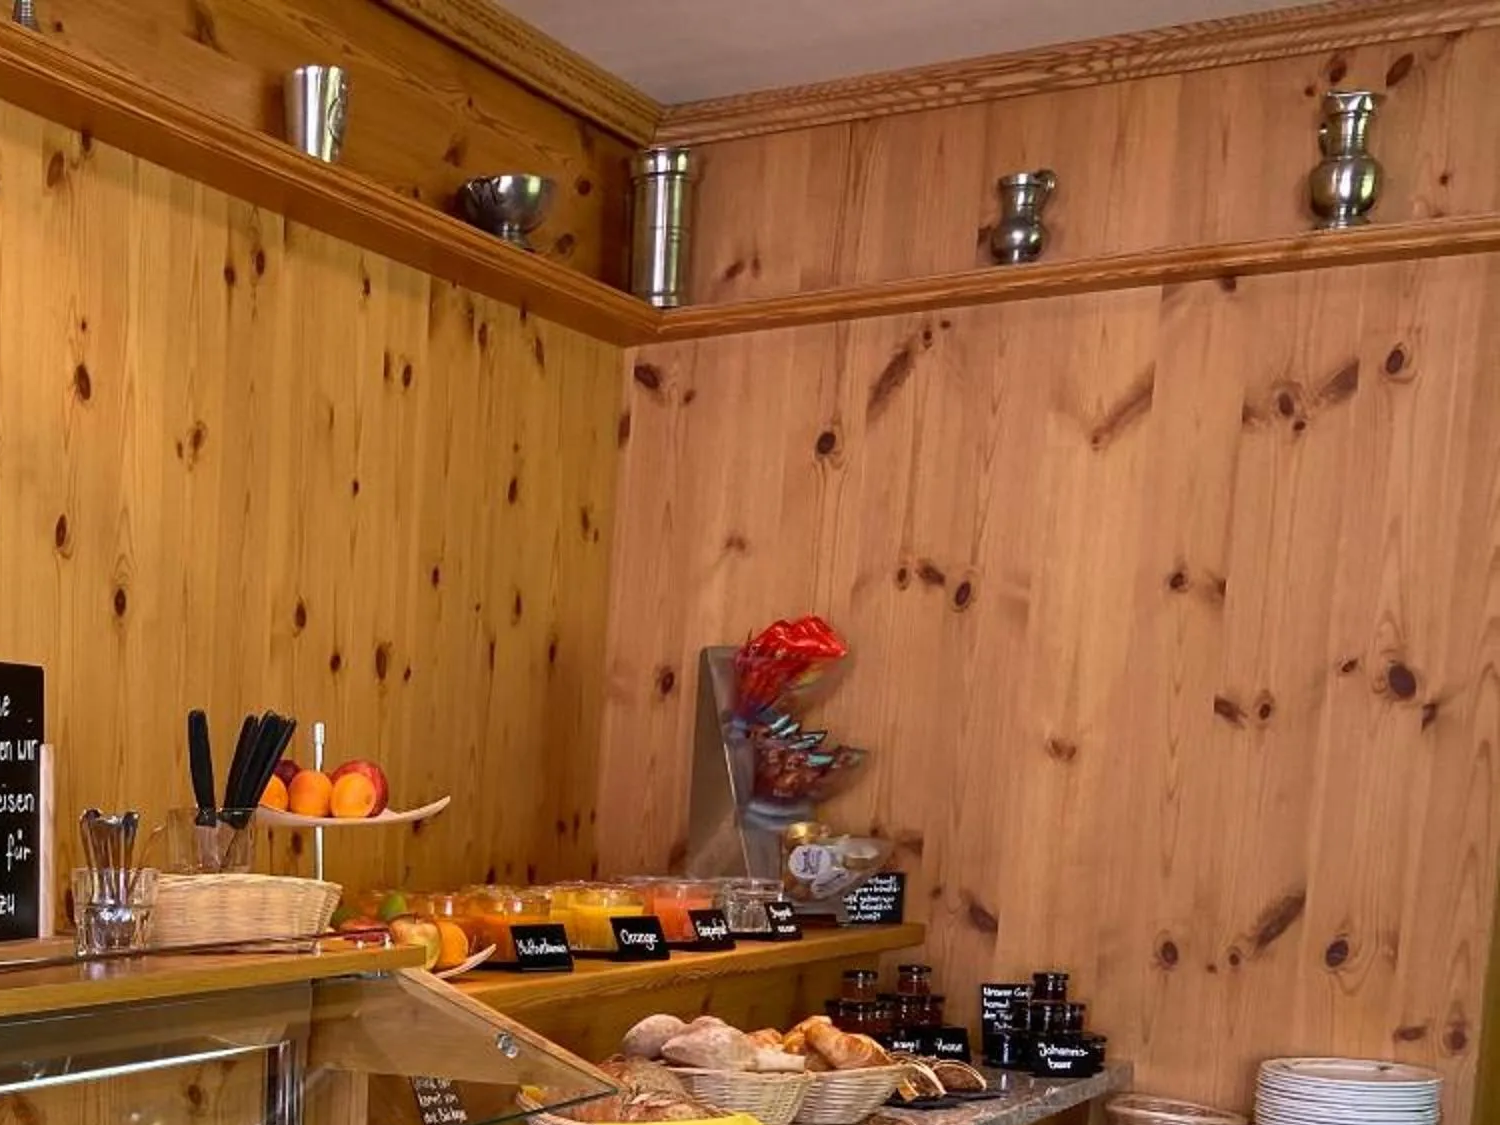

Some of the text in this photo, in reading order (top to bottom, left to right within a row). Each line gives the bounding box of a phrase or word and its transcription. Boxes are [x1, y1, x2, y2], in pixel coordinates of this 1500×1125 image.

[17, 736, 39, 761] wir
[6, 829, 31, 872] für
[620, 928, 659, 951] Orange
